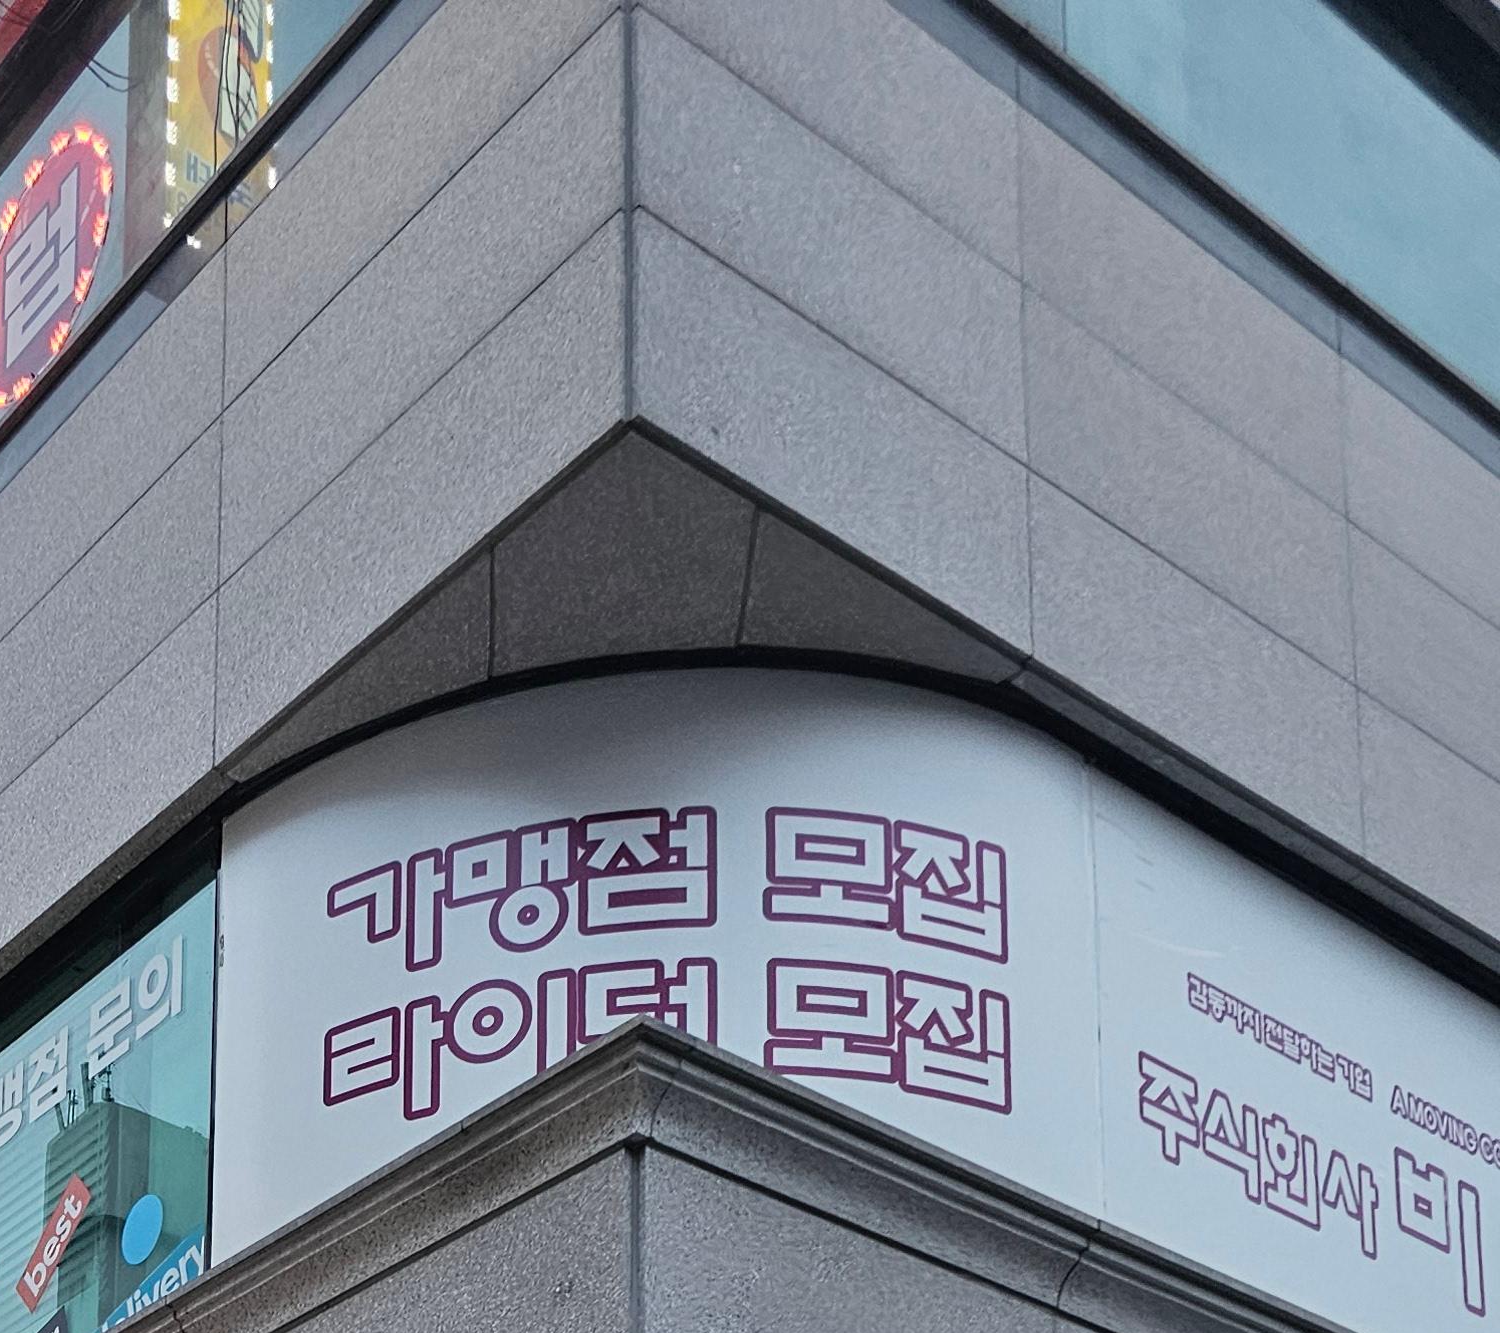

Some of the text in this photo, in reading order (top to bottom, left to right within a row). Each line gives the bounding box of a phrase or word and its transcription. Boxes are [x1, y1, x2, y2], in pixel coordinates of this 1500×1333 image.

[327, 805, 1009, 973] 가맹점 모집
[87, 933, 185, 1080] 문의
[323, 957, 1013, 1120] 라이더 모집
[1186, 971, 1262, 1043] 감동까지
[1336, 1053, 1373, 1102] 기업
[1390, 1085, 1408, 1116] A
[1407, 1091, 1477, 1154] MOVING
[1138, 1051, 1378, 1260] 주식회사
[23, 1192, 84, 1299] best
[102, 1235, 205, 1333] livery
